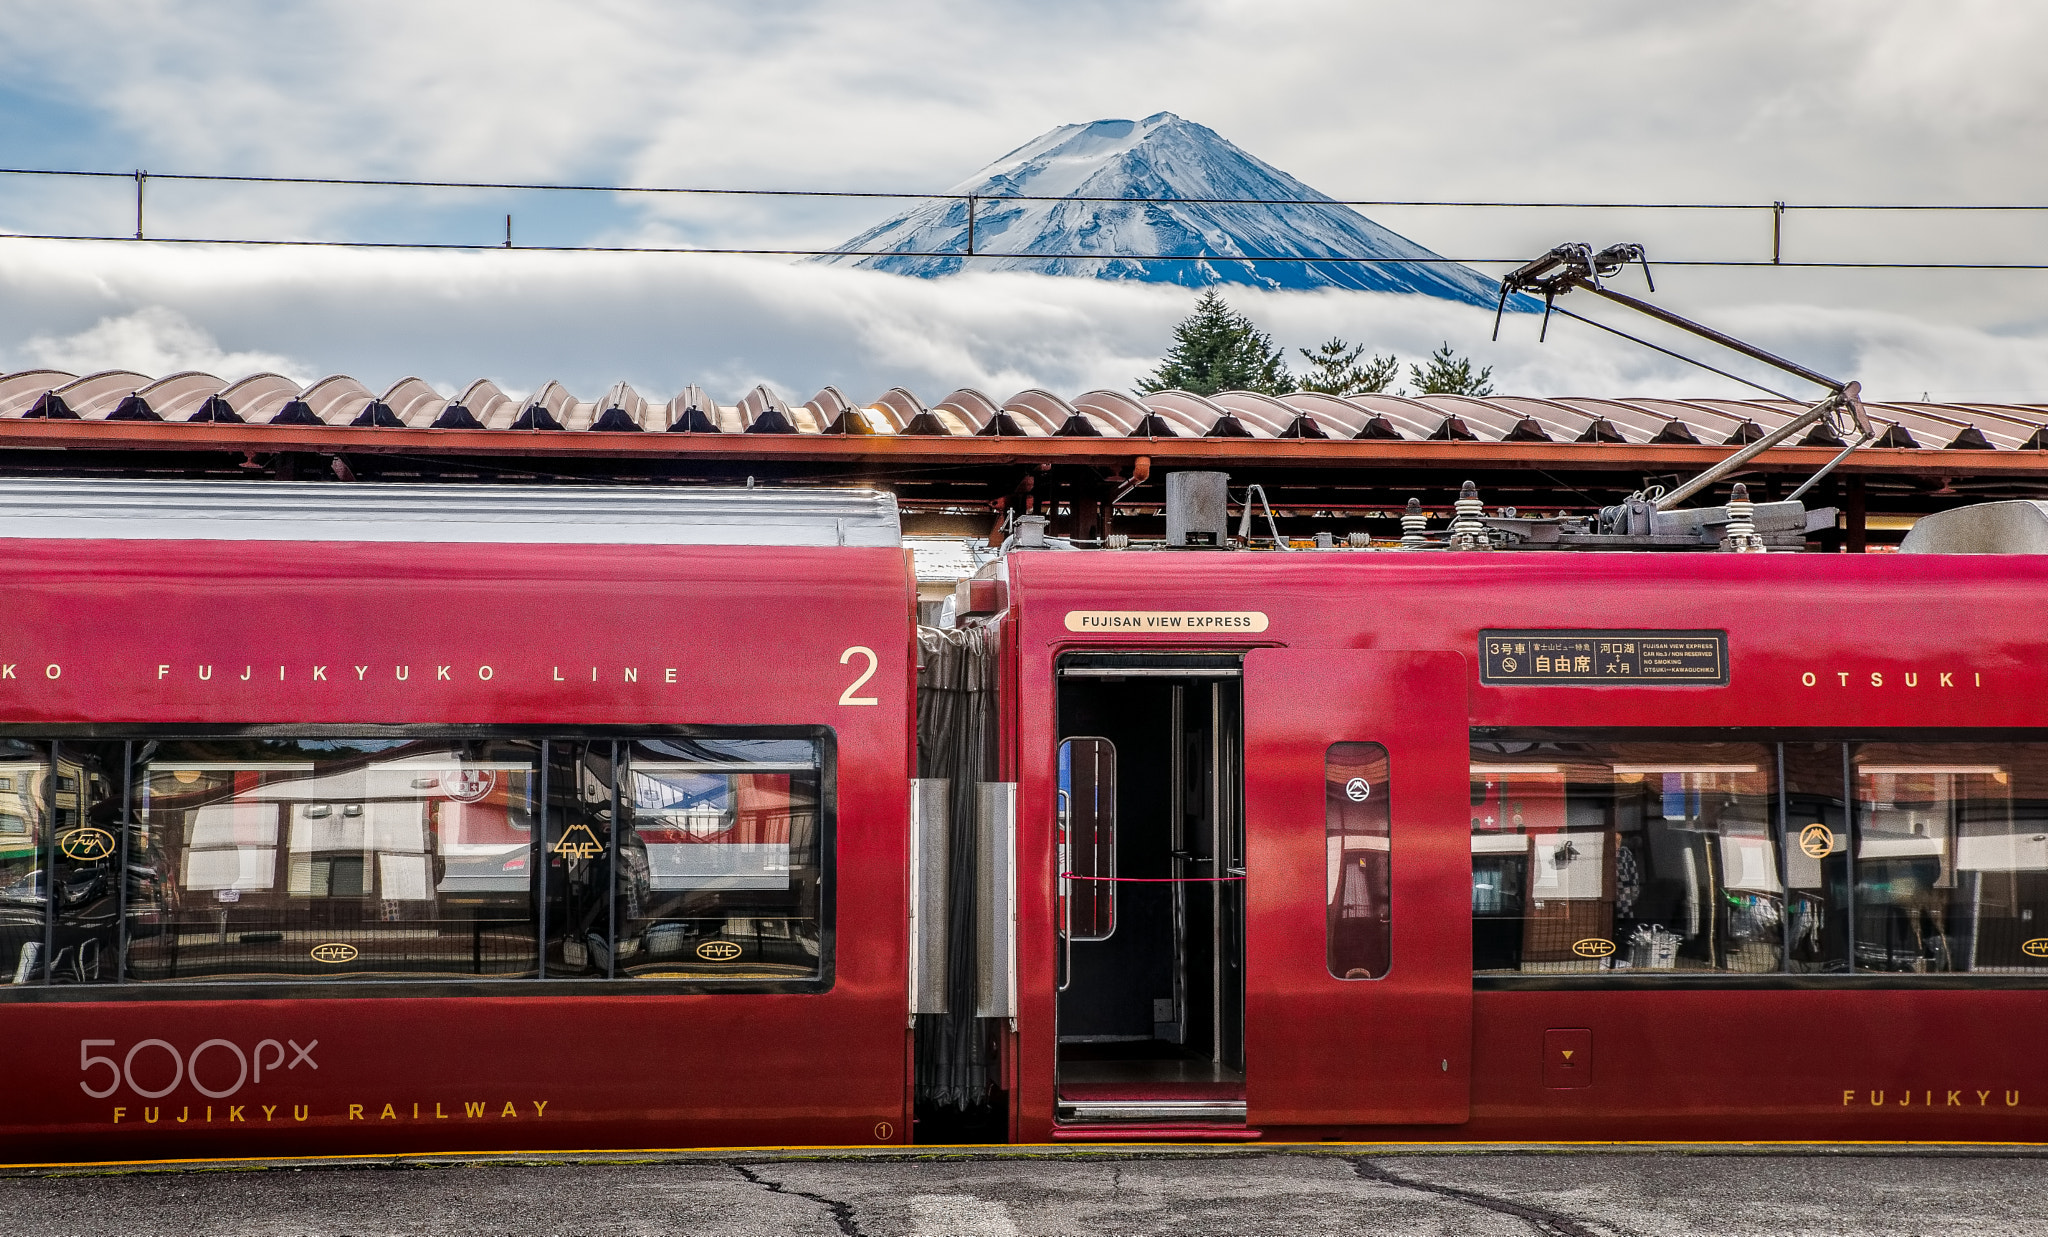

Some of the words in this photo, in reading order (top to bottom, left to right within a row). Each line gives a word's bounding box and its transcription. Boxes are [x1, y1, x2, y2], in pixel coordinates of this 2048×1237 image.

[1082, 616, 1141, 627] FUJISAN
[1147, 616, 1181, 627] VIEW
[1187, 616, 1251, 627] EXPRESS
[1490, 643, 1526, 656] 3号車
[1599, 643, 1635, 655] 河口湖
[1535, 655, 1591, 673] 自由席
[1605, 662, 1631, 674] 大月
[158, 664, 494, 681] FUJIKYUKO
[553, 666, 677, 683] LINE
[838, 645, 879, 706] 2
[1802, 671, 1981, 688] OTSUKI
[319, 947, 349, 959] FVE
[704, 945, 733, 957] FVE
[1580, 942, 1608, 954] FVE
[1843, 1090, 2020, 1107] FUJIKYU
[113, 1104, 309, 1124] FUJIKYU
[349, 1100, 548, 1121] RAILWAY
